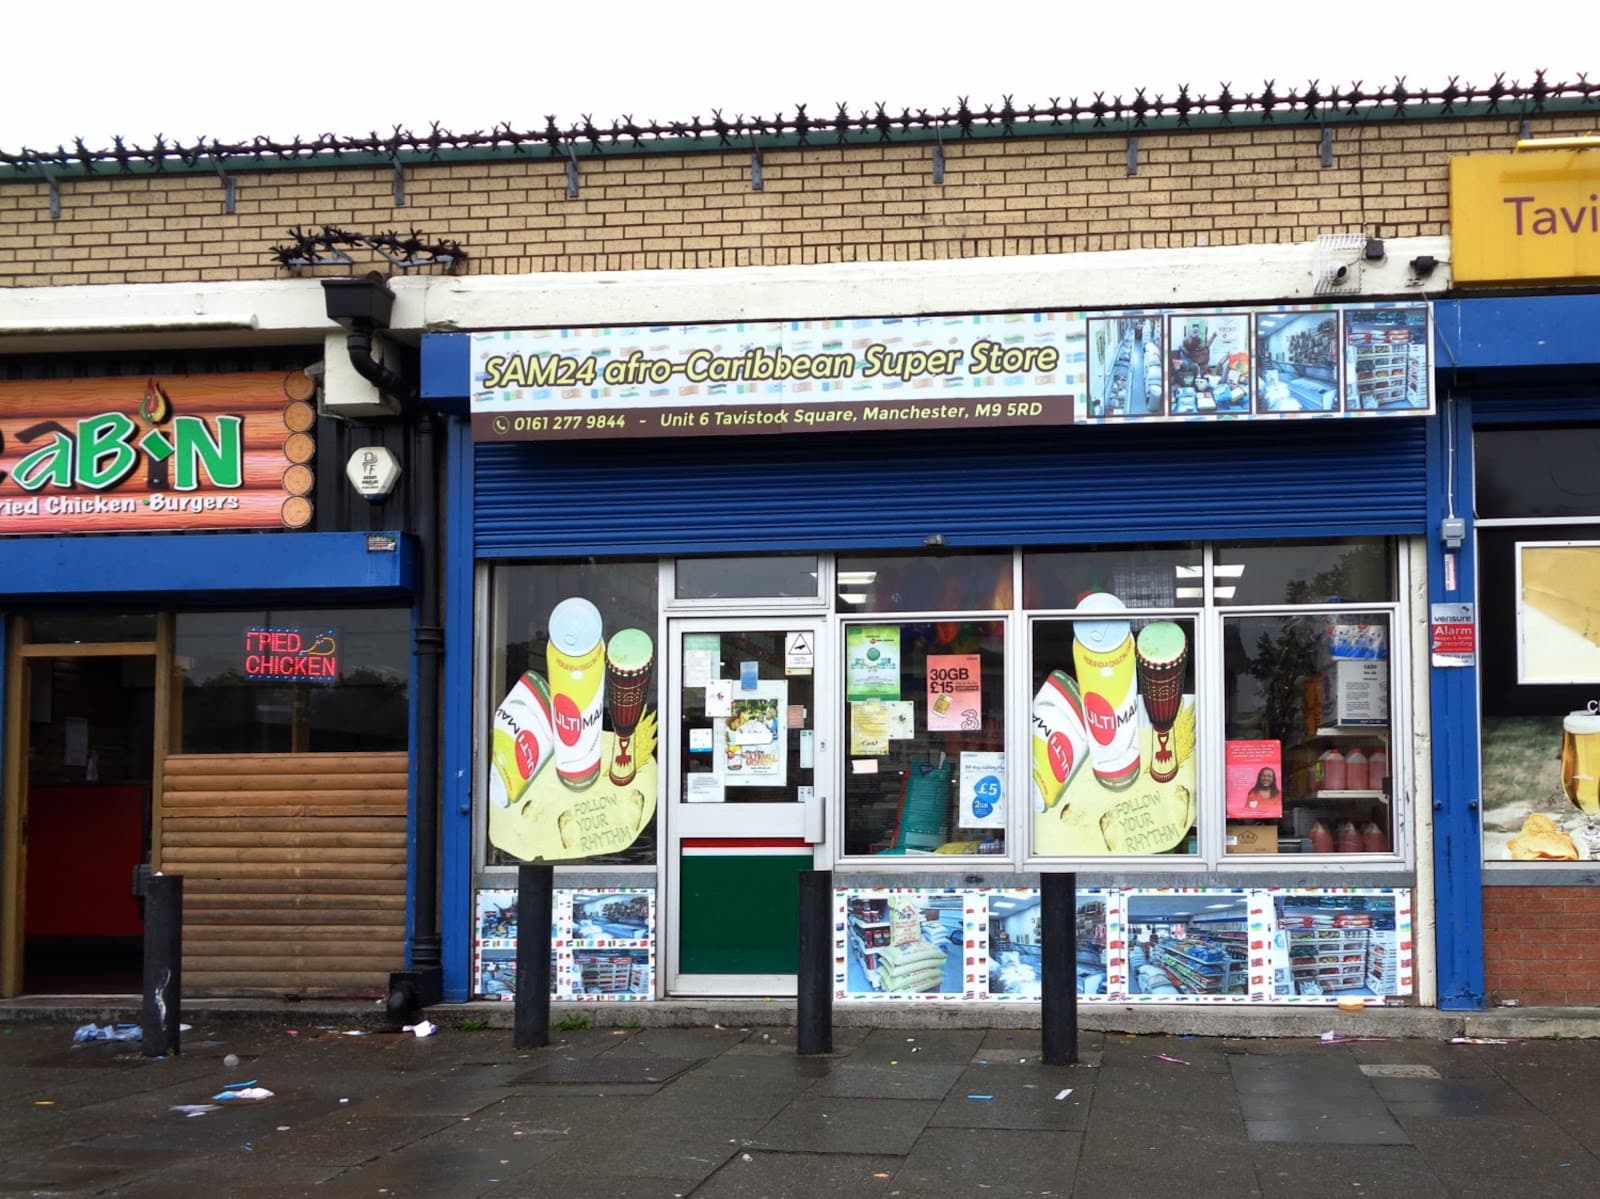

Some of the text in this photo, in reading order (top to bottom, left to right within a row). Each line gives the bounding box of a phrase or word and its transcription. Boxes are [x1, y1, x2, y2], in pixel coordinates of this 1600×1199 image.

[1503, 193, 1598, 236] Tavi
[484, 340, 1060, 389] SAM24 afro-Caribbean Super Store
[513, 416, 549, 431] 0161
[553, 415, 581, 430] 277
[585, 414, 626, 429] 9844
[660, 412, 695, 427] Unit
[699, 412, 710, 426] 6
[714, 408, 789, 425] Tavistock
[793, 407, 858, 425] Square,
[862, 404, 970, 421] Manchester,
[975, 403, 1002, 417] M9
[1006, 402, 1043, 416] 5RD
[45, 496, 137, 515] Chicken
[149, 493, 240, 513] Burgers
[1434, 625, 1472, 636] Alarm
[245, 654, 337, 676] CHICKEN
[930, 667, 969, 681] 30GB
[930, 681, 954, 694] £15
[978, 783, 998, 796] £5
[574, 793, 617, 816] FOLLOW
[1115, 790, 1161, 816] FOLLOW
[576, 813, 609, 831] YOUR
[1119, 812, 1155, 832] YOUR
[580, 825, 632, 852] RHYTHM
[1125, 823, 1180, 852] RHYTHM
